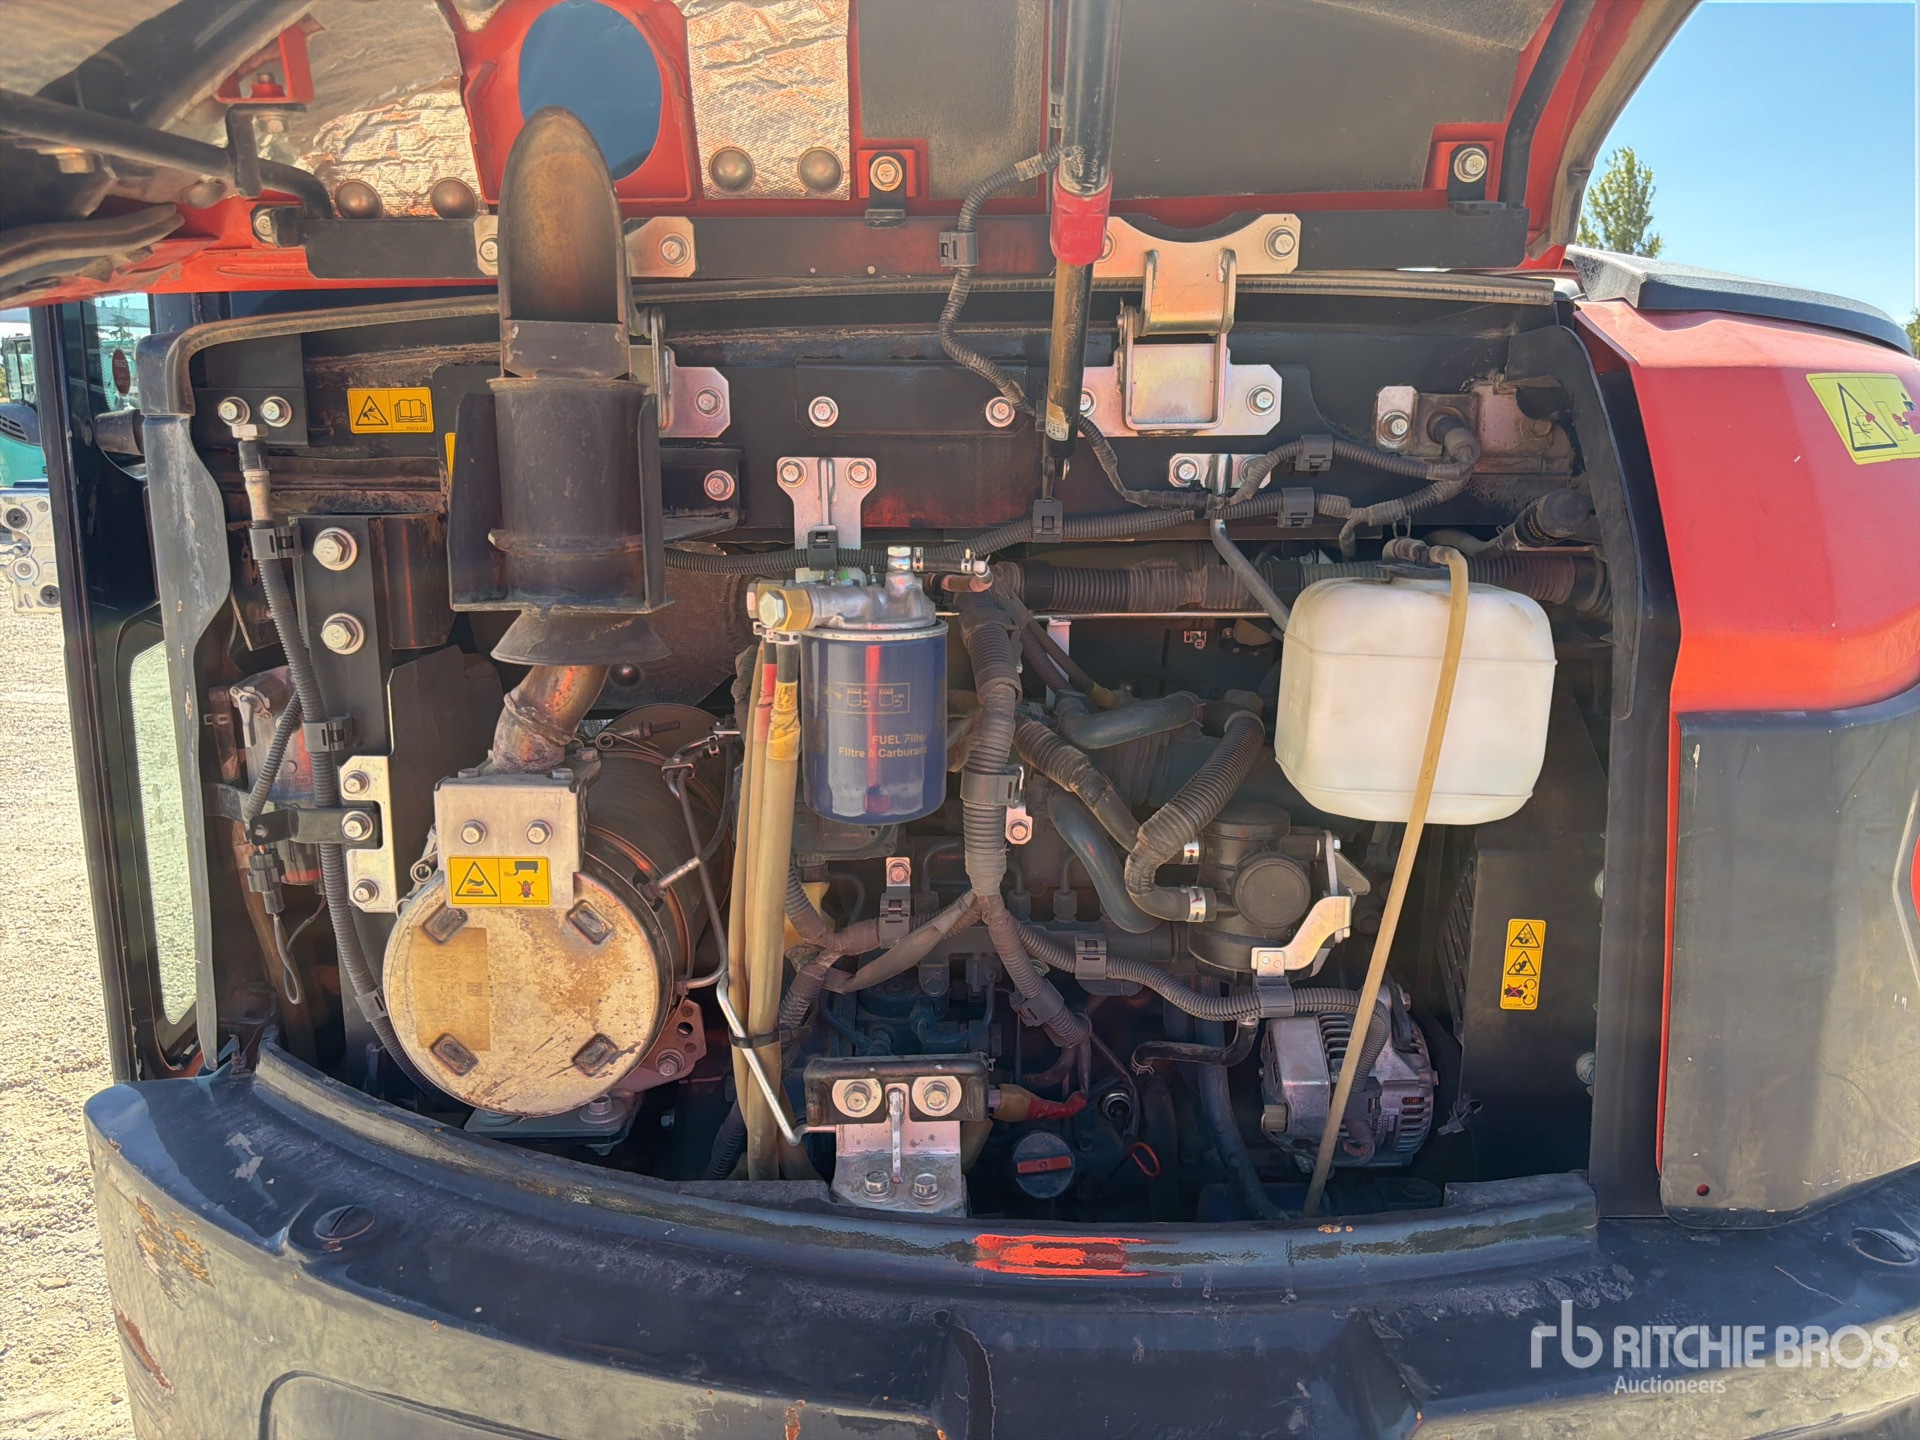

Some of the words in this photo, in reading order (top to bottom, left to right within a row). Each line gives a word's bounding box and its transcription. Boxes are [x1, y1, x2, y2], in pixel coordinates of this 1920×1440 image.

[873, 736, 901, 746] FUEL
[839, 747, 866, 758] Filtre
[878, 746, 927, 758] Carburant
